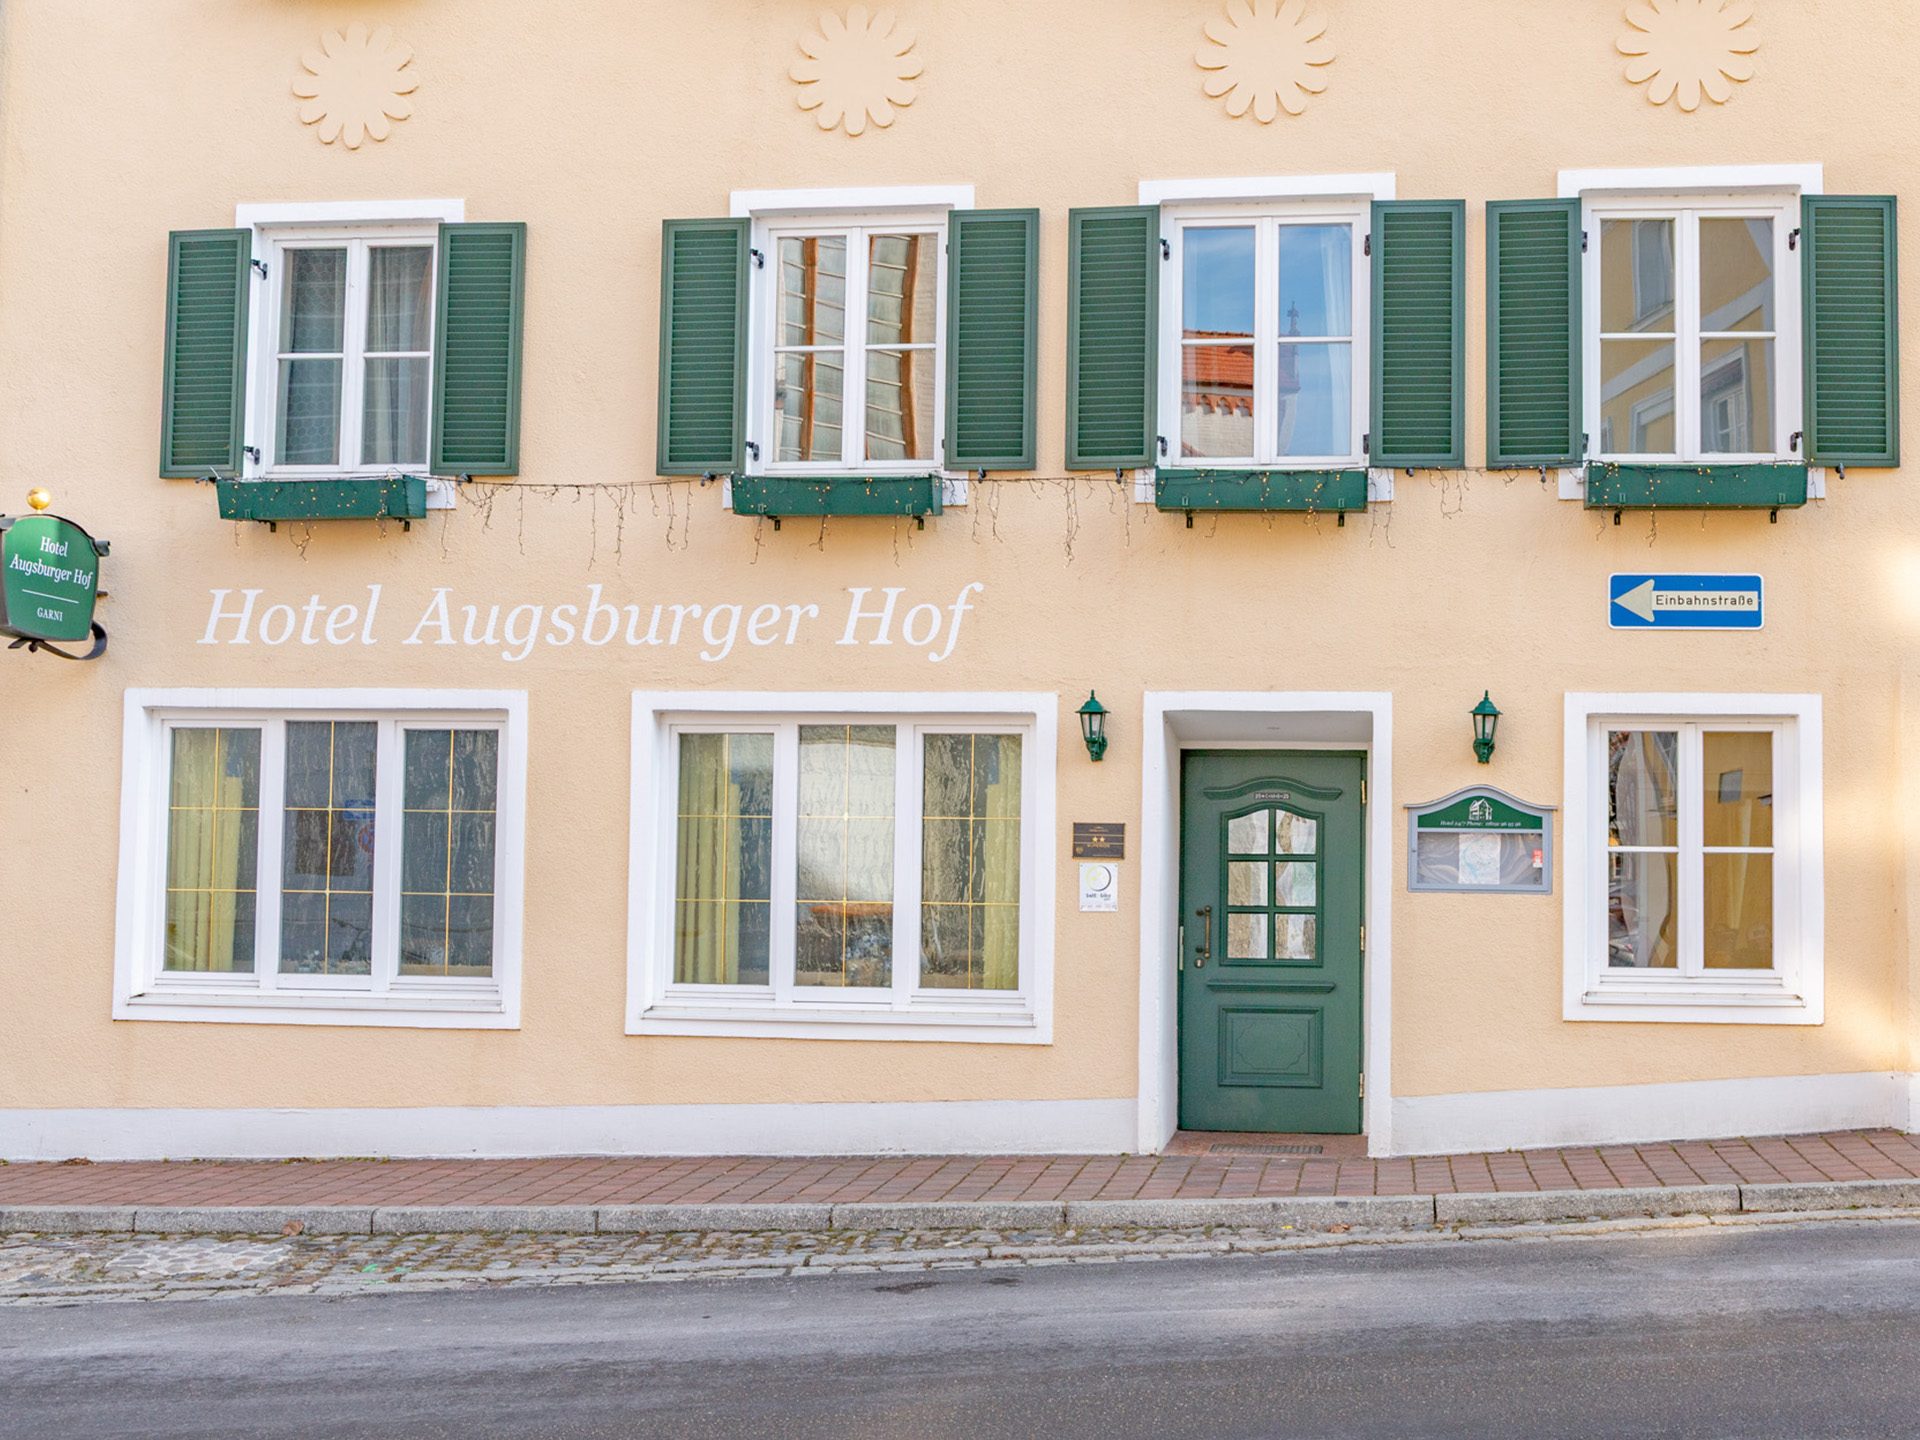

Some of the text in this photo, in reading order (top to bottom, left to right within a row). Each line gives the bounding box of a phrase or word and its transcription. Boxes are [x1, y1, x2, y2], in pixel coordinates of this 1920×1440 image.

[40, 536, 69, 557] Hotel
[9, 553, 94, 590] Augsburger Hof
[1655, 594, 1754, 606] Einbahnstraße
[37, 607, 63, 621] GARNI
[196, 581, 983, 663] Hotel Augsburger Hof
